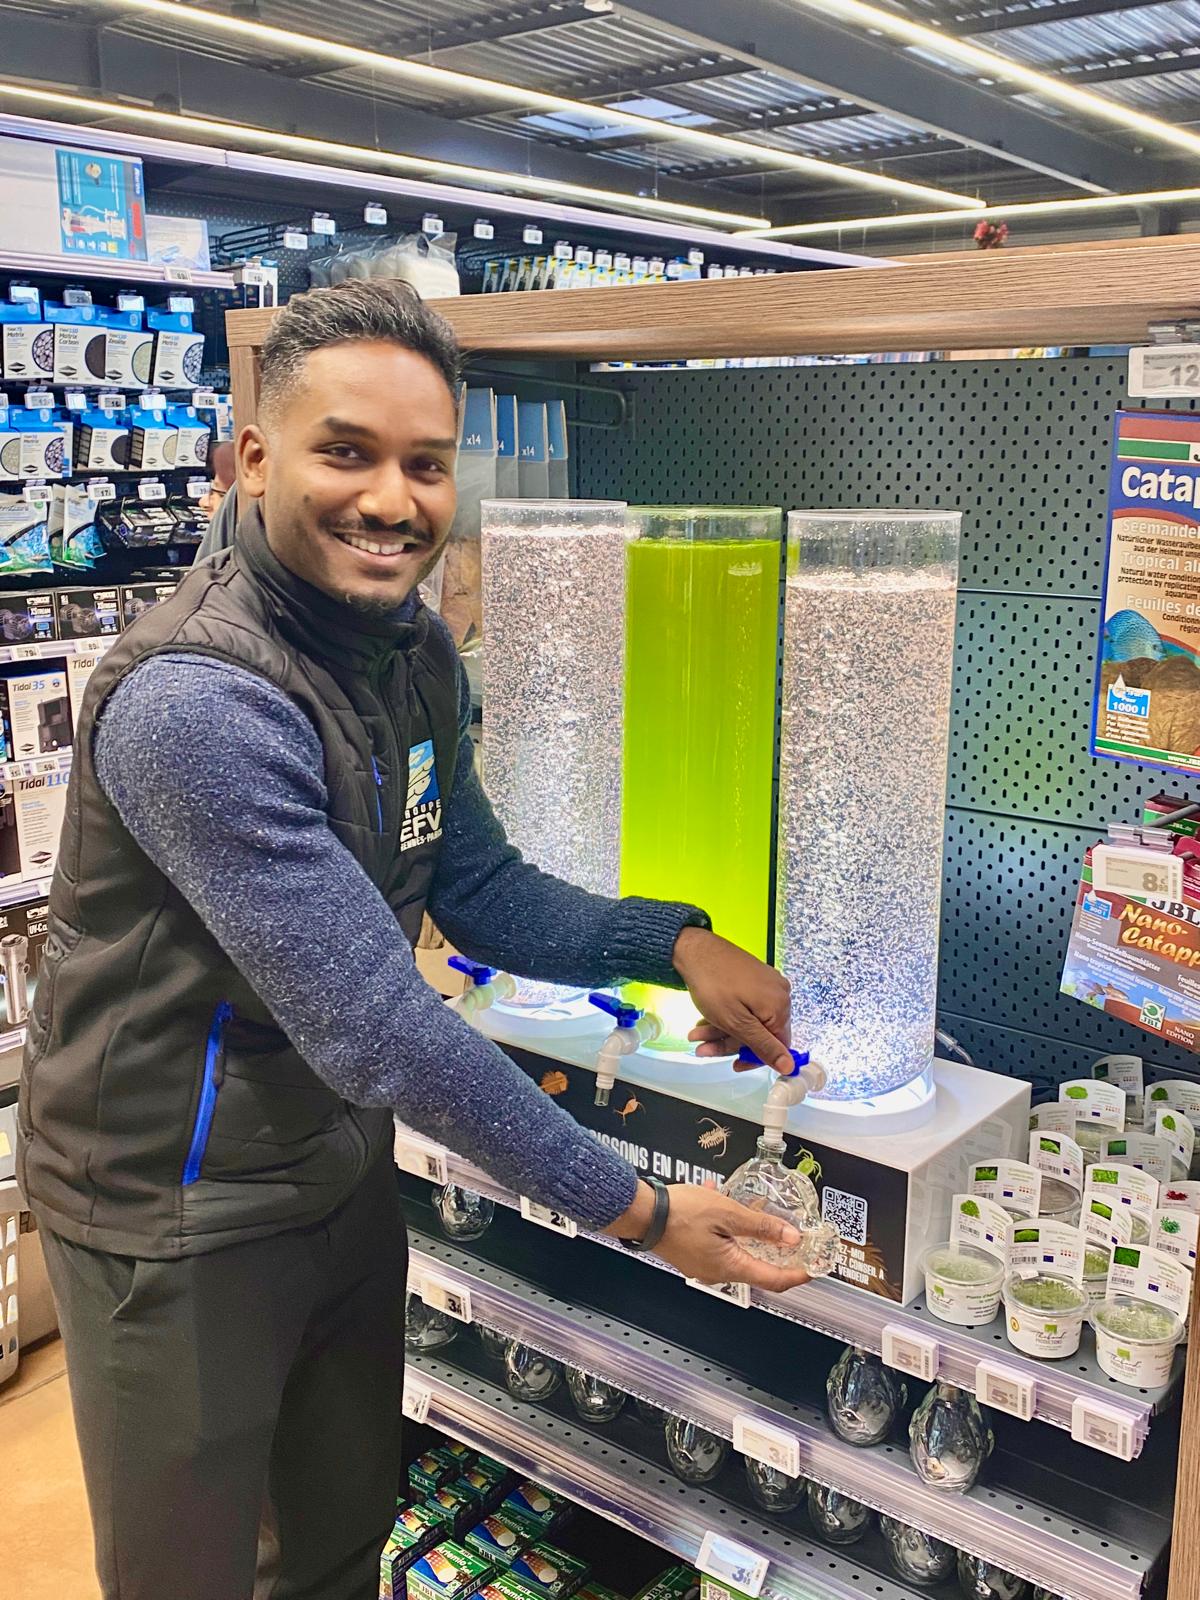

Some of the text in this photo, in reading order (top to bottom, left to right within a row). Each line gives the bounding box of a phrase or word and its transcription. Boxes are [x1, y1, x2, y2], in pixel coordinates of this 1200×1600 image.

[466, 434, 481, 446] x14
[521, 445, 535, 457] x14
[1146, 546, 1158, 554] der
[1122, 551, 1180, 570] Tropical
[1121, 567, 1146, 576] Natural
[1147, 570, 1168, 579] water
[1117, 575, 1153, 586] protection
[1154, 578, 1163, 588] by
[1165, 590, 1198, 599] aquarium
[1126, 594, 1182, 614] Feuilles
[72, 658, 95, 669] Tidal
[12, 680, 45, 692] Tidal 35
[1112, 701, 1139, 714] 1000
[19, 776, 45, 790] Tidal
[400, 807, 442, 843] EFV
[1117, 903, 1189, 935] Nano-
[1165, 1028, 1195, 1046] EDITION
[1174, 1025, 1195, 1040] NANO
[652, 1150, 672, 1179] EN
[493, 1512, 524, 1531] Artemio
[437, 1545, 467, 1566] Artemio
[480, 1547, 496, 1561] JBL
[532, 1546, 566, 1567] Artemio
